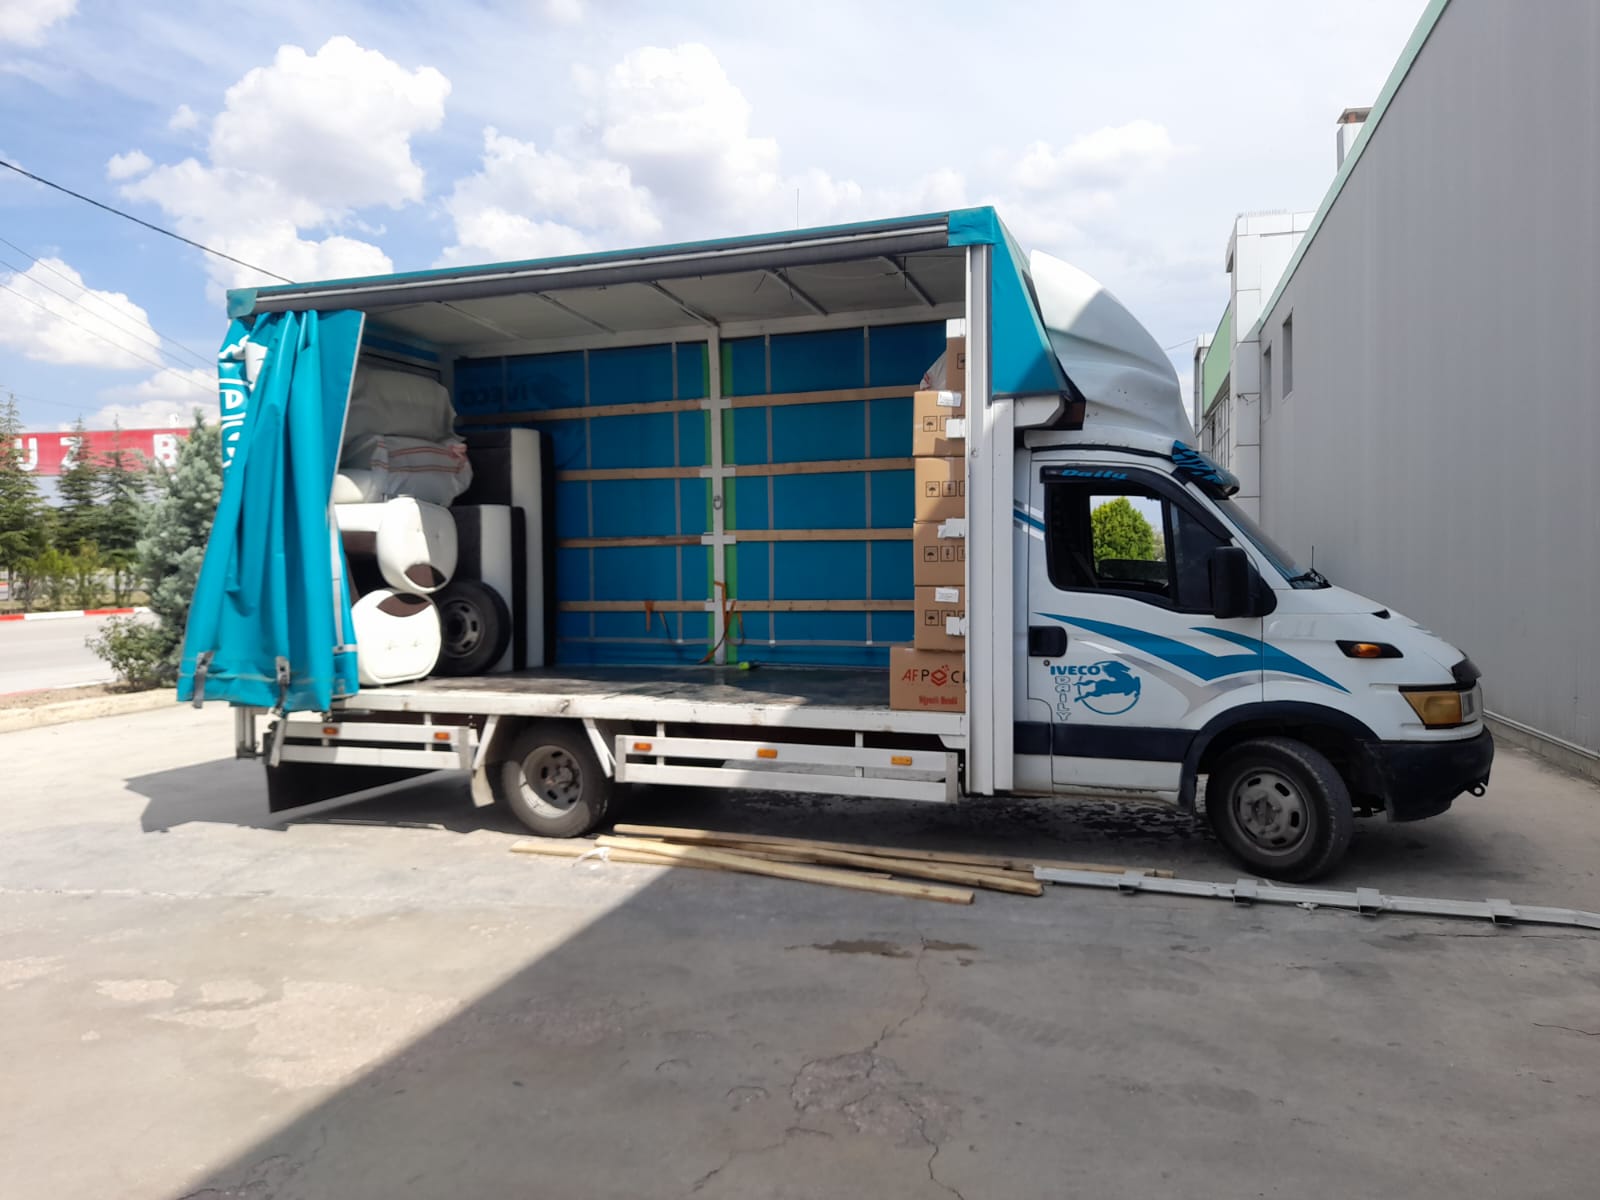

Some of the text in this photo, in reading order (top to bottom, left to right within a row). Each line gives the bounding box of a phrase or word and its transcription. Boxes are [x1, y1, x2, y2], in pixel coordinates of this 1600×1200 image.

[1062, 469, 1129, 480] Daily
[1050, 665, 1101, 676] IVECO
[1054, 676, 1072, 721] DAILY
